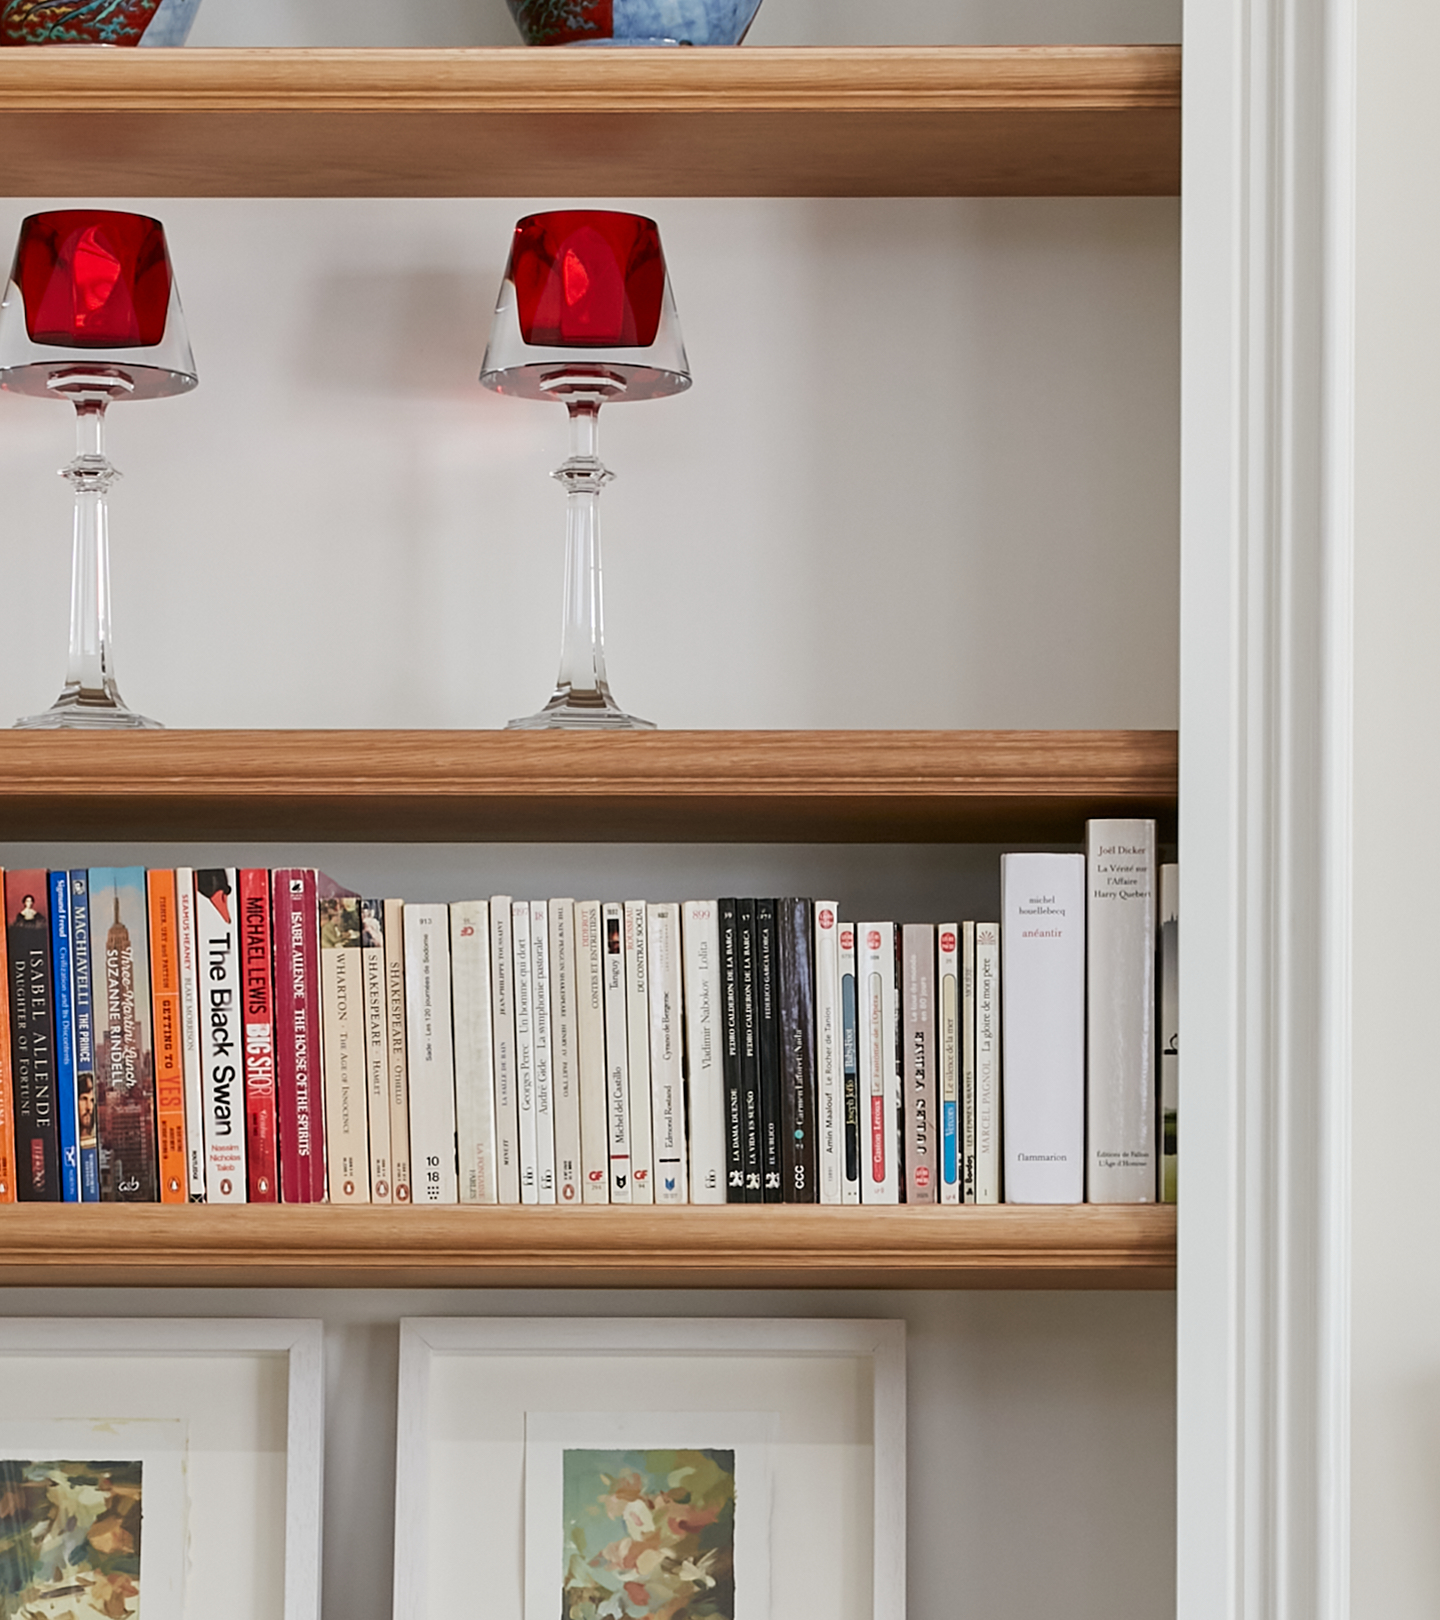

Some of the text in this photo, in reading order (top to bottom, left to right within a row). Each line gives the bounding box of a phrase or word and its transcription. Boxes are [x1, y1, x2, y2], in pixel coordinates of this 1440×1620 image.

[1097, 846, 1146, 856] Joël Dicker
[1097, 865, 1108, 873] La
[1110, 864, 1134, 873] Vérité
[1107, 878, 1138, 886] l'Affaire
[56, 880, 68, 938] Sigmund Freud
[1019, 907, 1066, 917] houellebecq
[1029, 896, 1055, 904] michel
[1094, 890, 1151, 900] Harry Quebert
[74, 906, 89, 1006] MACHIAVELLI
[181, 894, 192, 971] SEAMUS HEANEY
[246, 896, 267, 1015] MICHAEL LEWIS
[291, 911, 302, 947] ISABEL
[698, 941, 709, 970] Lolita
[1022, 928, 1063, 938] anéantir
[28, 950, 47, 1021] ISABEL
[59, 947, 70, 992] Civilization
[62, 994, 71, 1007] and
[292, 949, 305, 998] ALLENDE
[609, 960, 620, 990] Tanguy
[14, 960, 32, 1117] DAUGHTER OF FORTUNE
[62, 1020, 71, 1065] Discontents
[78, 1013, 91, 1063] THE PRINCE
[106, 949, 123, 1087] SUZANNE RINDELL
[119, 947, 139, 1089] Three-Martini Lunch
[162, 999, 174, 1069] GETTING TO
[184, 977, 195, 1051] BLAKE MORRISON
[208, 932, 236, 1136] The Black Swan
[246, 1023, 271, 1054] BIG
[335, 953, 351, 1135] WHARTON THE AGE OF INNOCENCE
[368, 955, 382, 1096] SHAKESPEARE HAMLET
[390, 961, 403, 1105] SHAKESPEARE OTHELLO
[516, 939, 532, 1111] Georges Perec Un homme qui dort
[533, 936, 548, 1116] André Gide La symphonie pastorale
[699, 979, 712, 1070] Vladimir Nabokov
[32, 1032, 51, 1128] ALLENDE
[159, 1075, 182, 1107] YES
[293, 1009, 310, 1156] THE HOUSE OF THE SPIRITS
[613, 1067, 625, 1144] Michel del Castillo
[913, 1031, 927, 1156] JULES VERNE
[981, 1061, 991, 1153] MARCEL PAGNOL
[663, 1086, 674, 1148] Edmond Rostand
[872, 1101, 883, 1163] Gaston Leroux
[426, 1156, 440, 1167] 10
[426, 1171, 440, 1182] 18
[794, 1165, 805, 1189] CCC
[1017, 1153, 1068, 1162] flammarion
